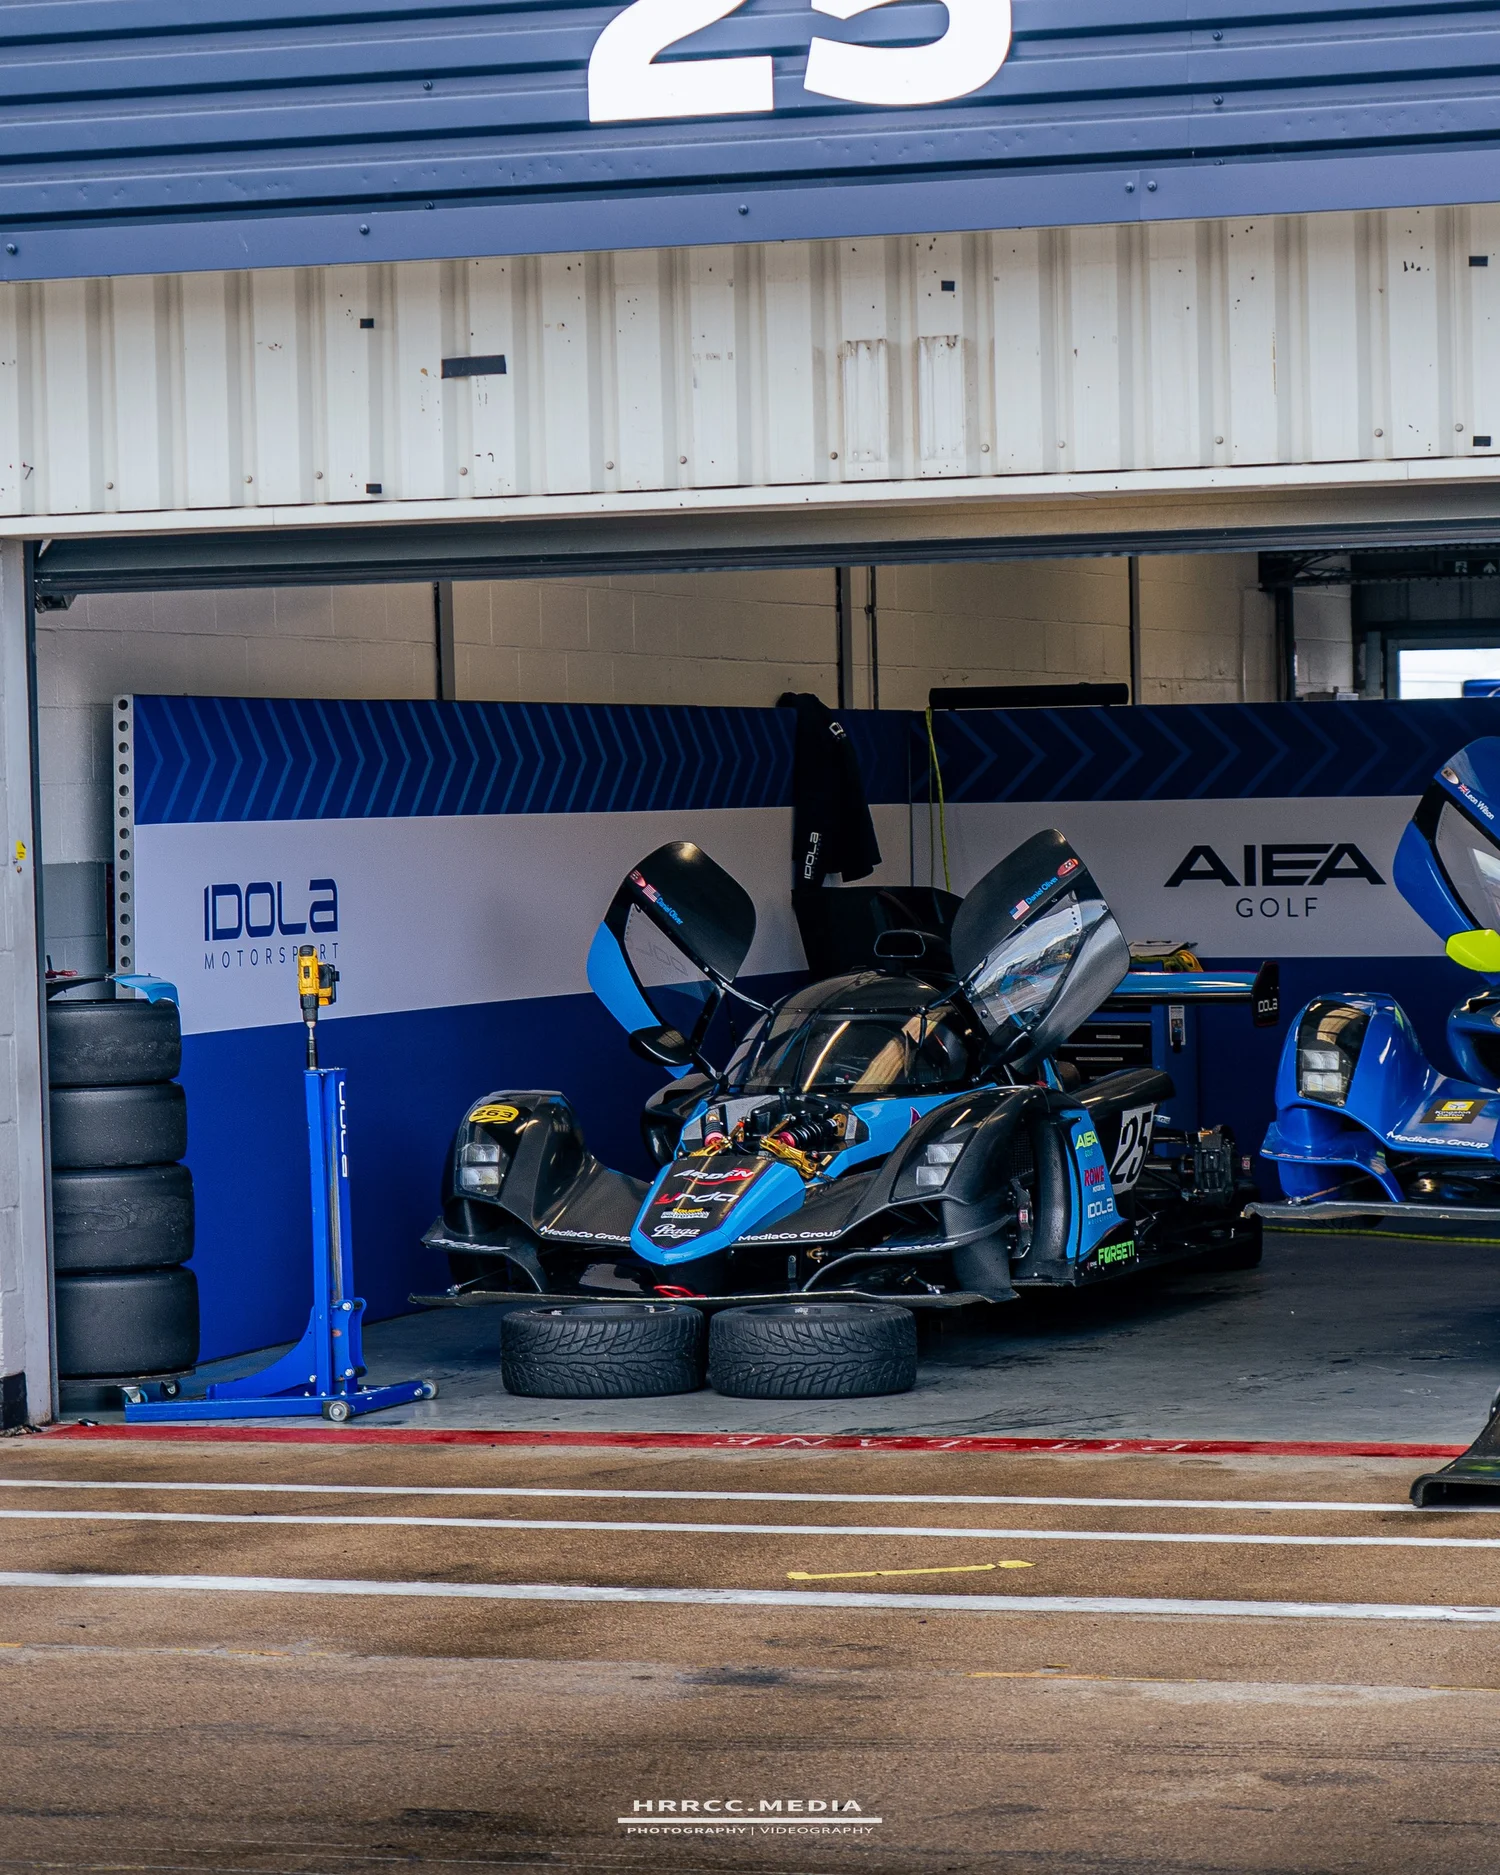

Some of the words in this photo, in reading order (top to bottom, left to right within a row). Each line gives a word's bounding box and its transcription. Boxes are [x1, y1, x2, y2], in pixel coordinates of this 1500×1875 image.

[1163, 843, 1387, 887] AIEA
[1235, 897, 1319, 918] GOLF
[204, 943, 339, 970] MOTORSPRT
[472, 1108, 515, 1120] 263
[1075, 1130, 1099, 1150] AIEA
[1109, 1110, 1153, 1186] 25
[1386, 1130, 1446, 1145] MediaCo
[1446, 1139, 1490, 1149] Group
[1084, 1165, 1105, 1187] ROWE
[539, 1225, 594, 1238] MediaCo
[594, 1232, 632, 1242] Group
[737, 1232, 798, 1242] MediaCo
[799, 1229, 842, 1239] Group
